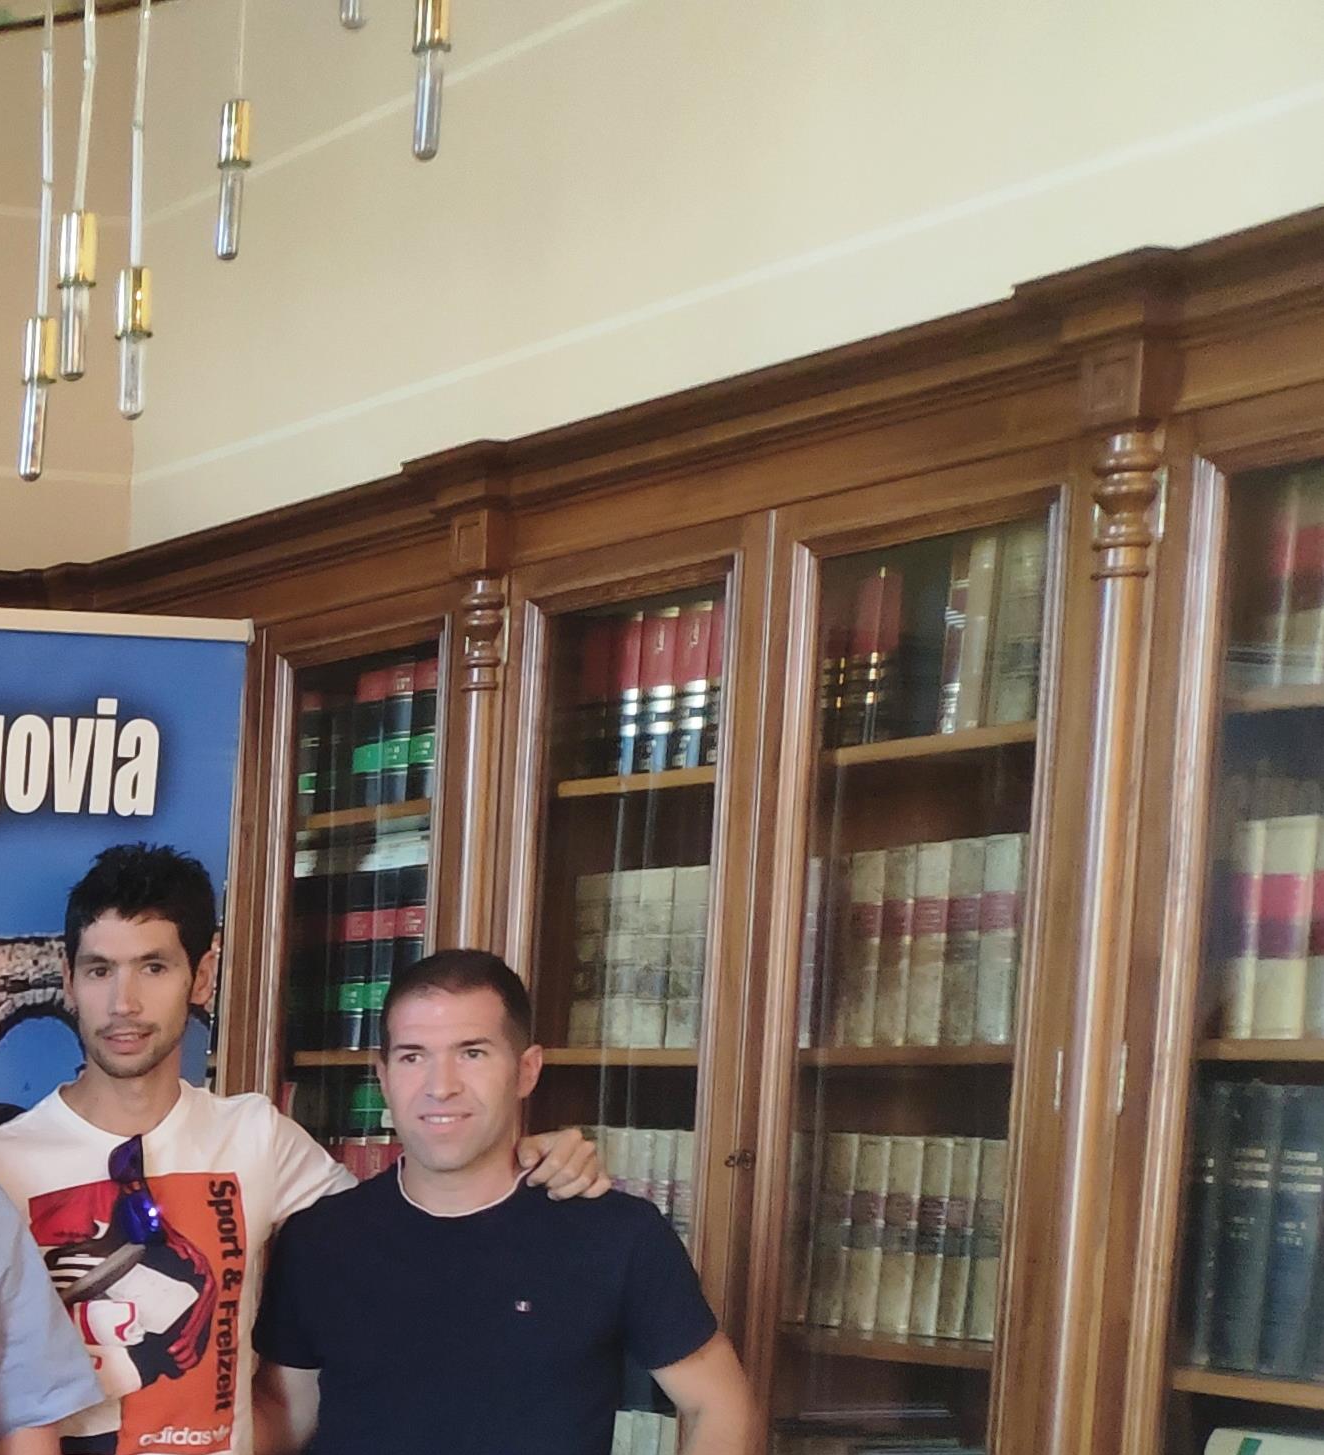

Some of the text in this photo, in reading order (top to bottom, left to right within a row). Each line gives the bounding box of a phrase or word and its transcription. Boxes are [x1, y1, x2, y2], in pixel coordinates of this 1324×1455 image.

[208, 1178, 244, 1413] Sport & Freizeit
[138, 1425, 212, 1448] adidas
